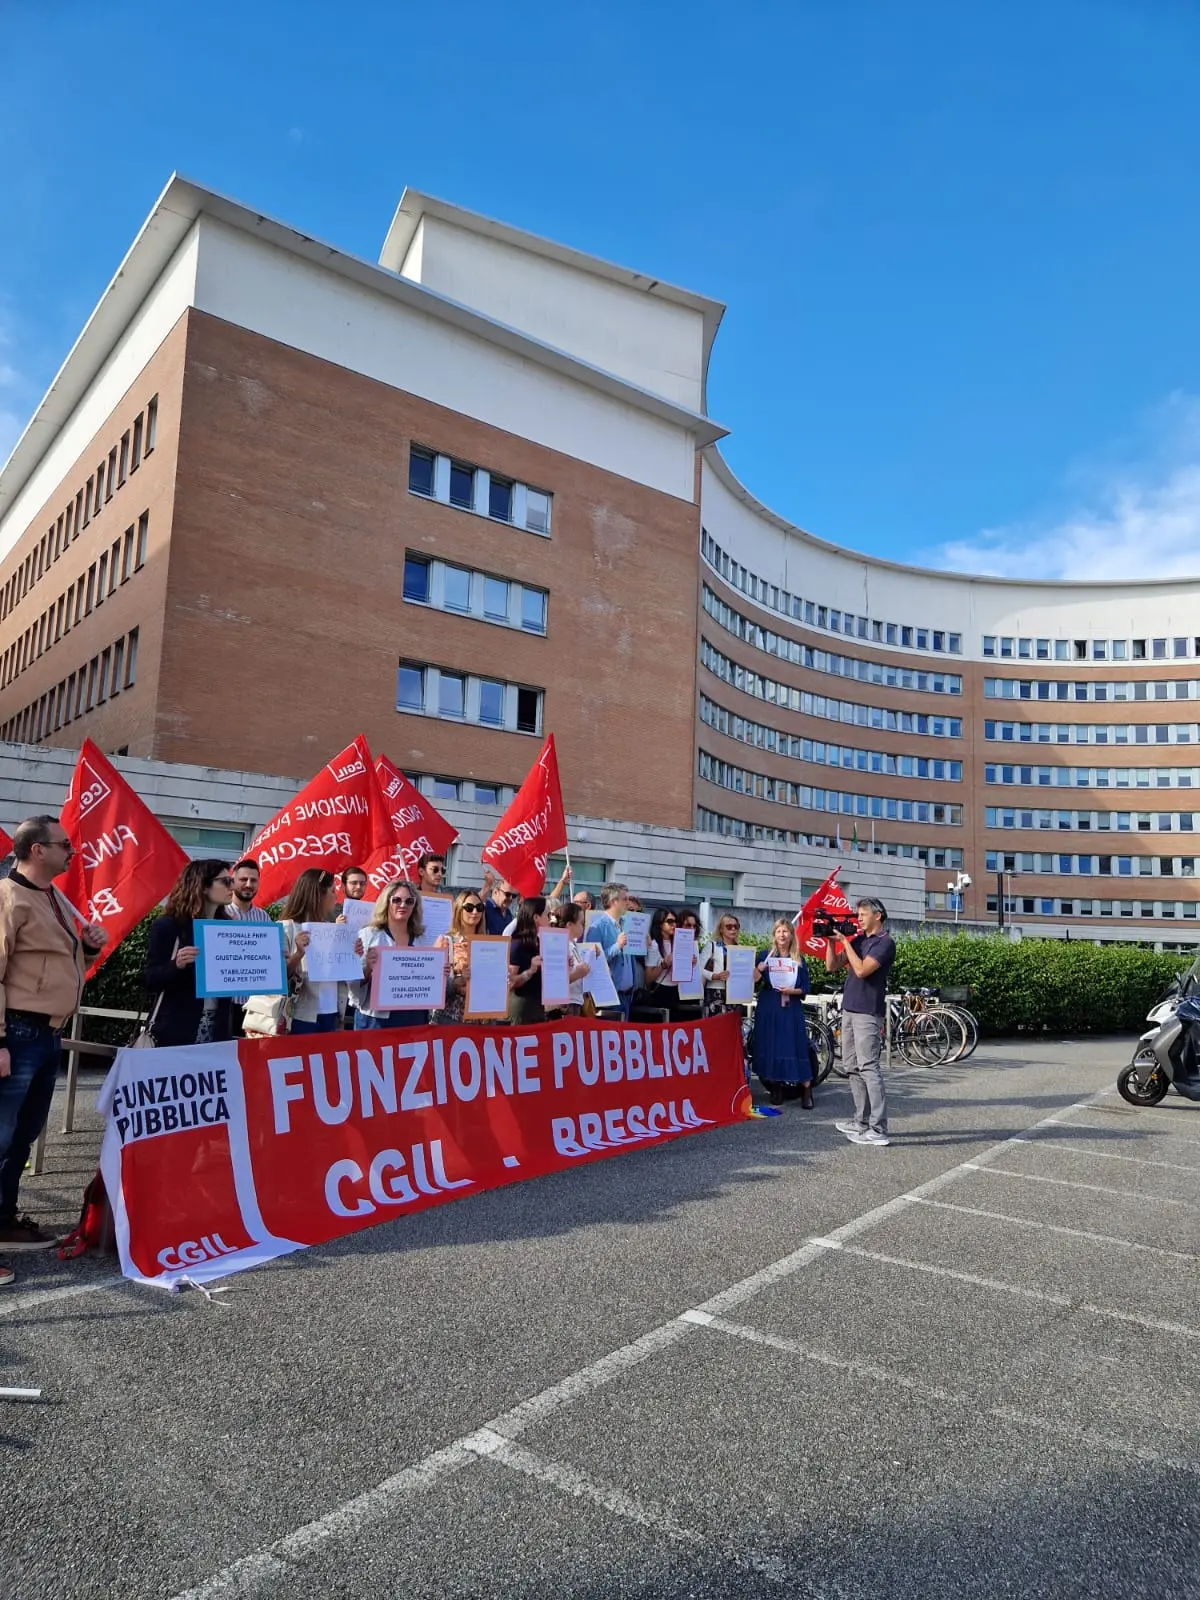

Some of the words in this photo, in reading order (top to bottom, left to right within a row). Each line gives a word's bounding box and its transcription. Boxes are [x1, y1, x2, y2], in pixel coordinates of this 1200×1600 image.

[112, 1069, 228, 1117] FUNZIONE
[267, 1036, 541, 1135] FUNZIONE
[552, 1028, 710, 1089] PUBBLICA
[116, 1097, 231, 1144] PUBBLICA
[324, 1139, 476, 1217] CGIL
[552, 1098, 717, 1157] BRESCIA
[157, 1233, 239, 1269] CGIL
